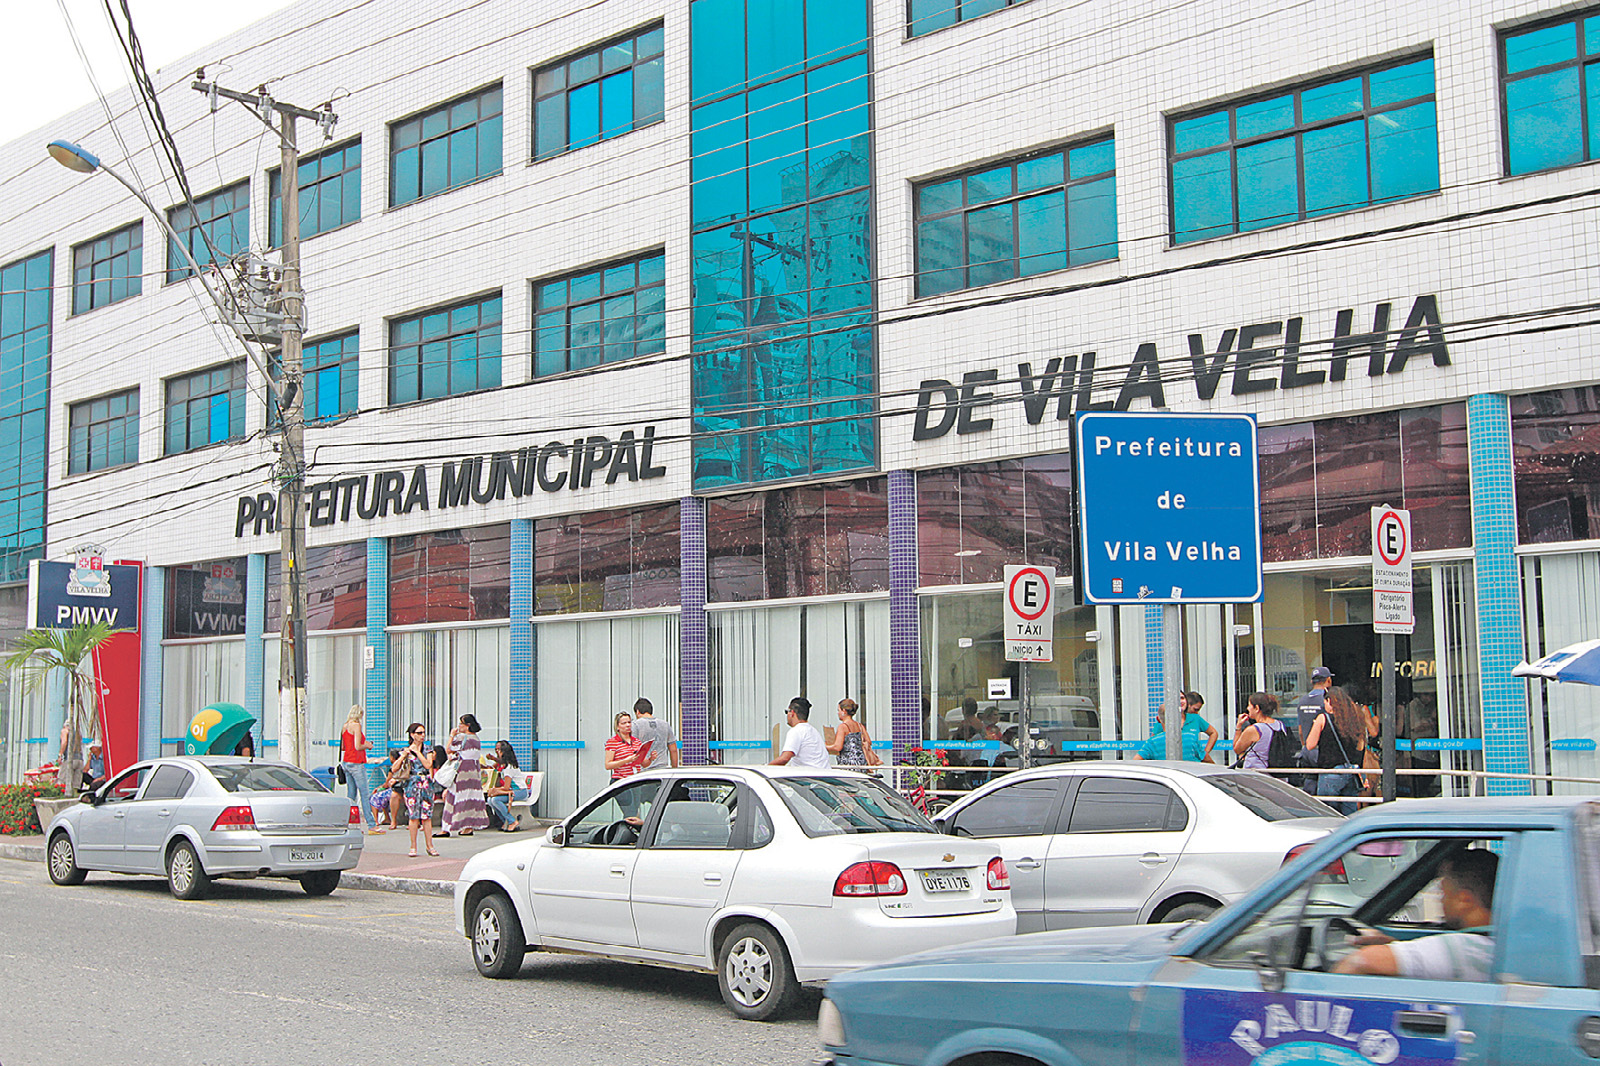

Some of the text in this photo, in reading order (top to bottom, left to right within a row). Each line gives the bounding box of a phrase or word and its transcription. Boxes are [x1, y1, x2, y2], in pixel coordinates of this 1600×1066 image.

[912, 294, 1452, 442] DE VILA VELHA
[1095, 435, 1242, 457] Prefeitura
[235, 426, 666, 538] PREITURA MUNICIPAL
[1157, 490, 1186, 510] de
[1387, 523, 1397, 554] E
[1104, 541, 1241, 562] Vila Velha
[69, 585, 108, 594] VILA VELHA
[1024, 580, 1038, 608] E
[57, 605, 118, 626] PMVV
[1385, 612, 1401, 621] Ligado
[1017, 622, 1042, 636] TÁXI
[192, 721, 205, 737] oi
[926, 877, 969, 890] OYE-1176
[1229, 1000, 1400, 1064] PAULO
